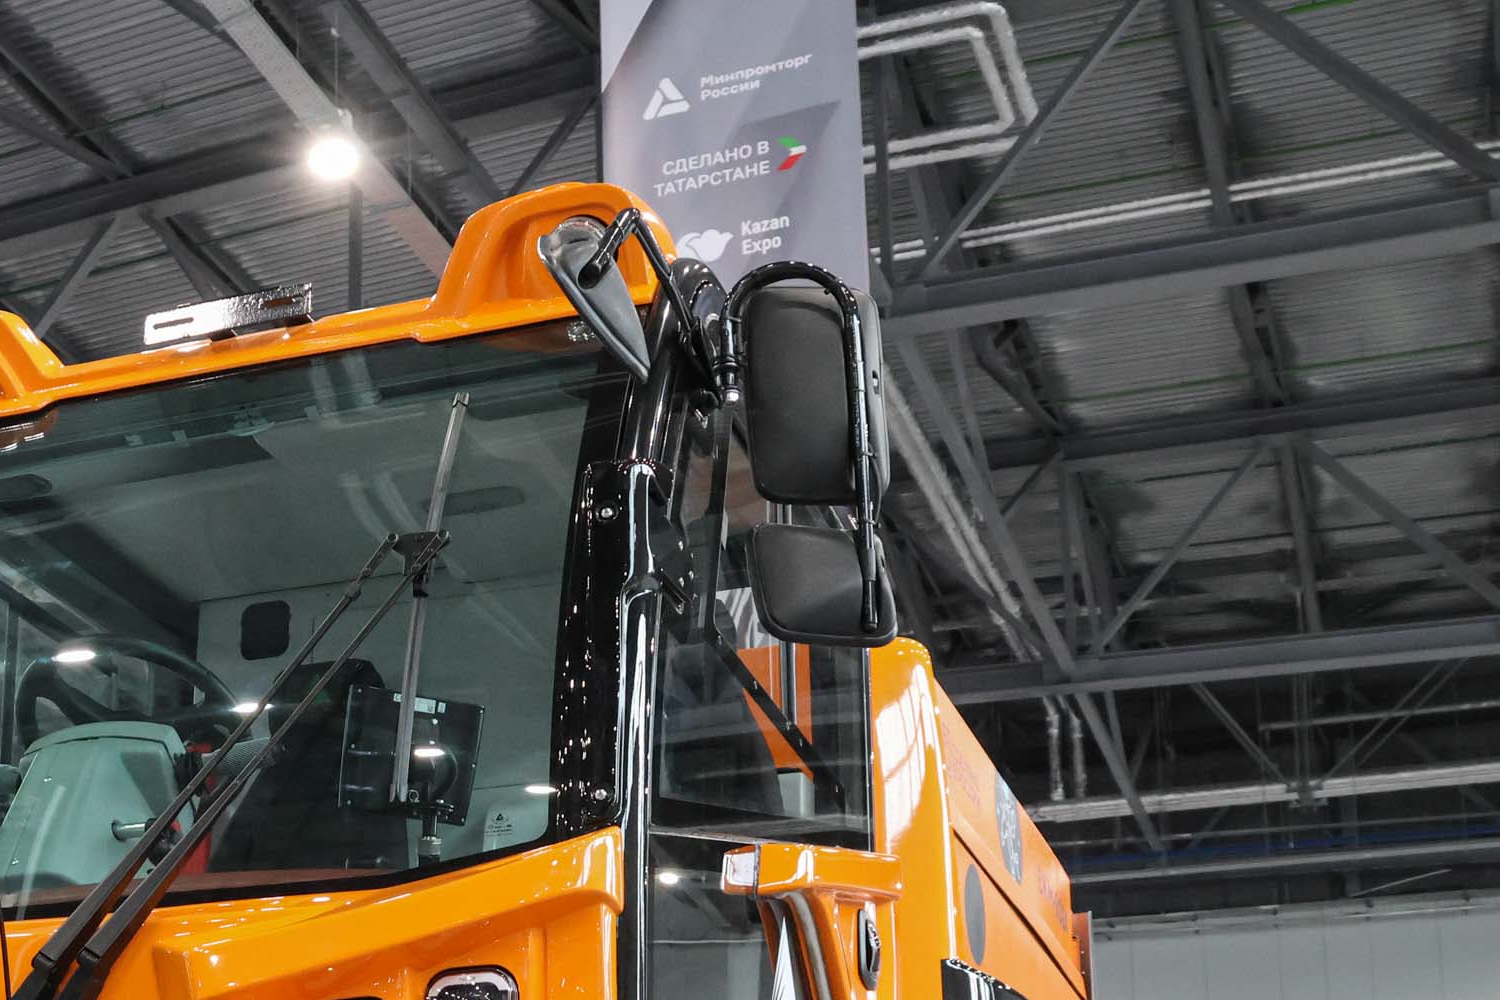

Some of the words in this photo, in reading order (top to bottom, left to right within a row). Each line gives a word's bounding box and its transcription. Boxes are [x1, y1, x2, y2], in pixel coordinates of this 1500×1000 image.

[700, 54, 813, 88] Минпромторг
[700, 79, 760, 101] России
[662, 144, 752, 175] СДЕЛАНО
[757, 140, 770, 155] В
[653, 160, 771, 197] ТАТАРСТАНЕ
[741, 215, 790, 236] Kazan
[742, 236, 782, 255] Expo
